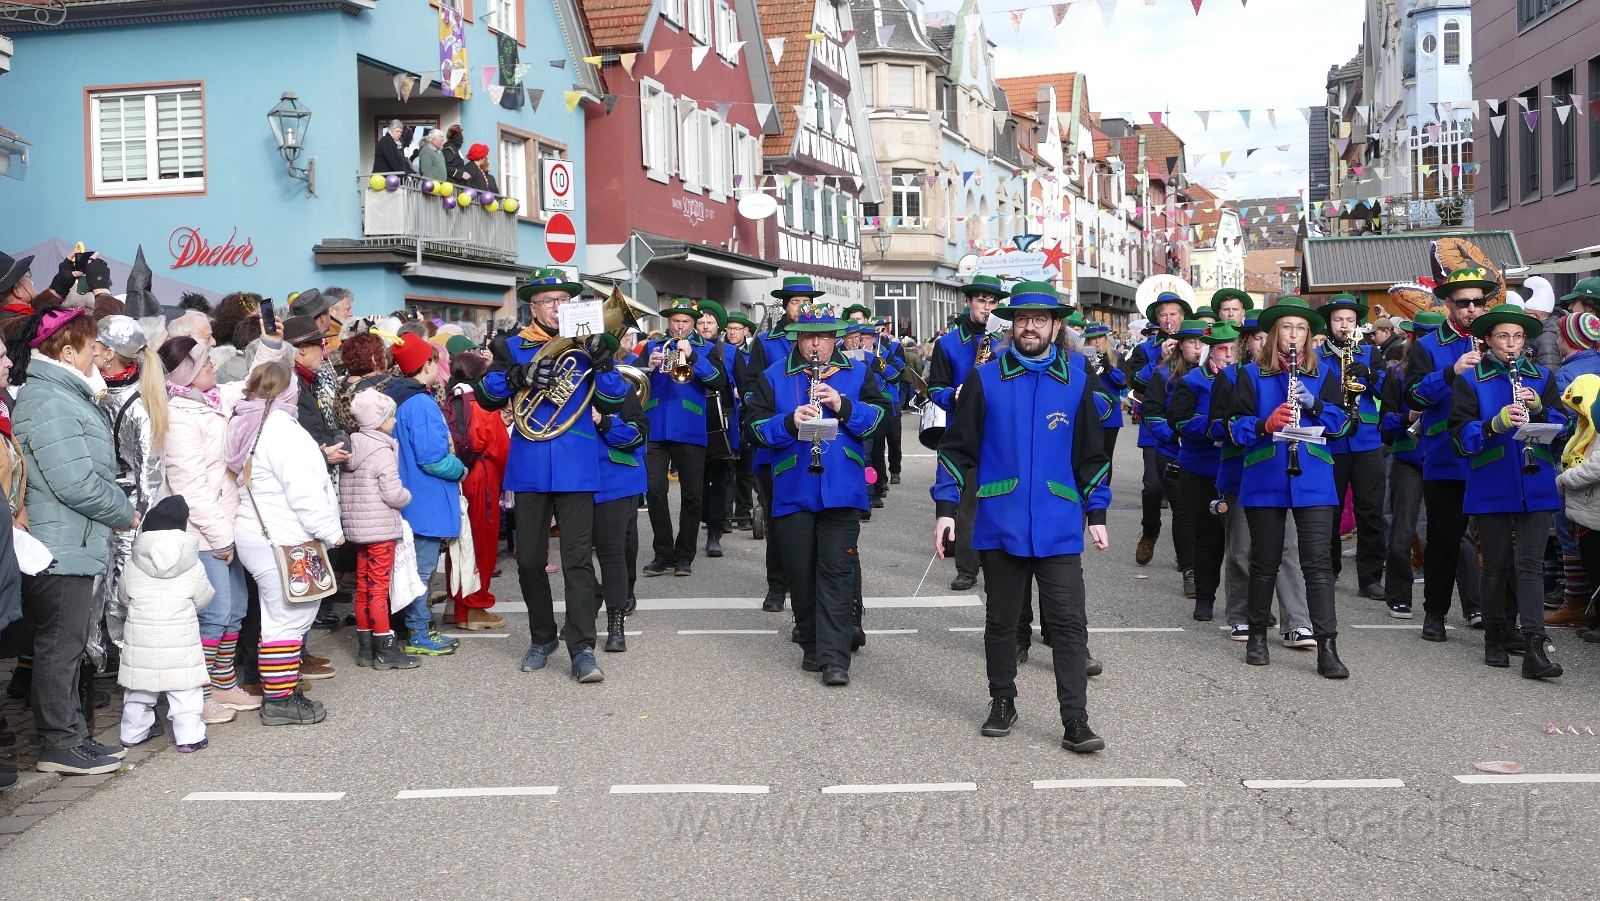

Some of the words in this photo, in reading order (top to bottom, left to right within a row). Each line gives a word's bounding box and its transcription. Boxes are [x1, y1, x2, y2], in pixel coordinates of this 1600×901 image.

[555, 172, 565, 188] 10
[552, 198, 568, 208] ZONE
[168, 225, 258, 269] Dreher
[818, 281, 850, 298] BUCHHANDLUNG
